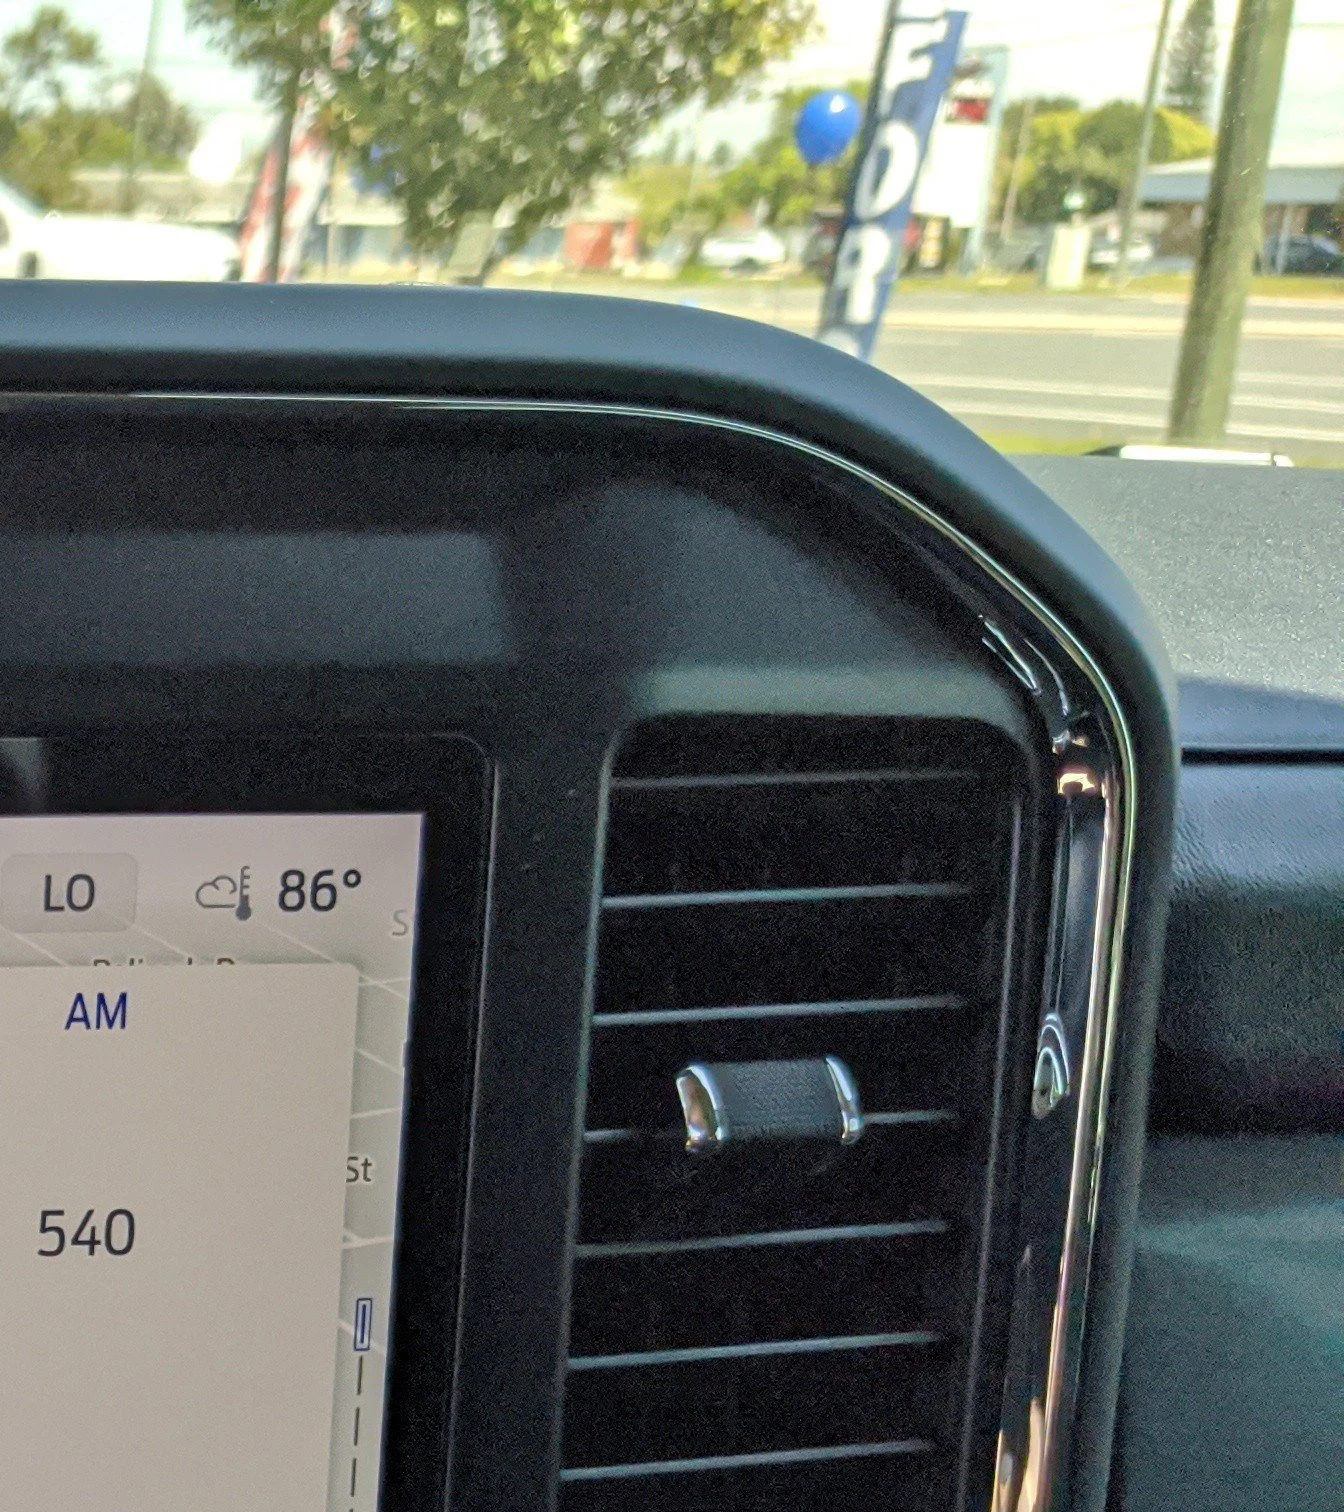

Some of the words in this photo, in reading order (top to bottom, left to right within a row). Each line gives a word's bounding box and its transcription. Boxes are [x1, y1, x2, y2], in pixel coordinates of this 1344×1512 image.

[812, 14, 953, 357] FOR
[42, 874, 96, 913] LO
[64, 991, 129, 1031] AM
[36, 1208, 137, 1259] 540
